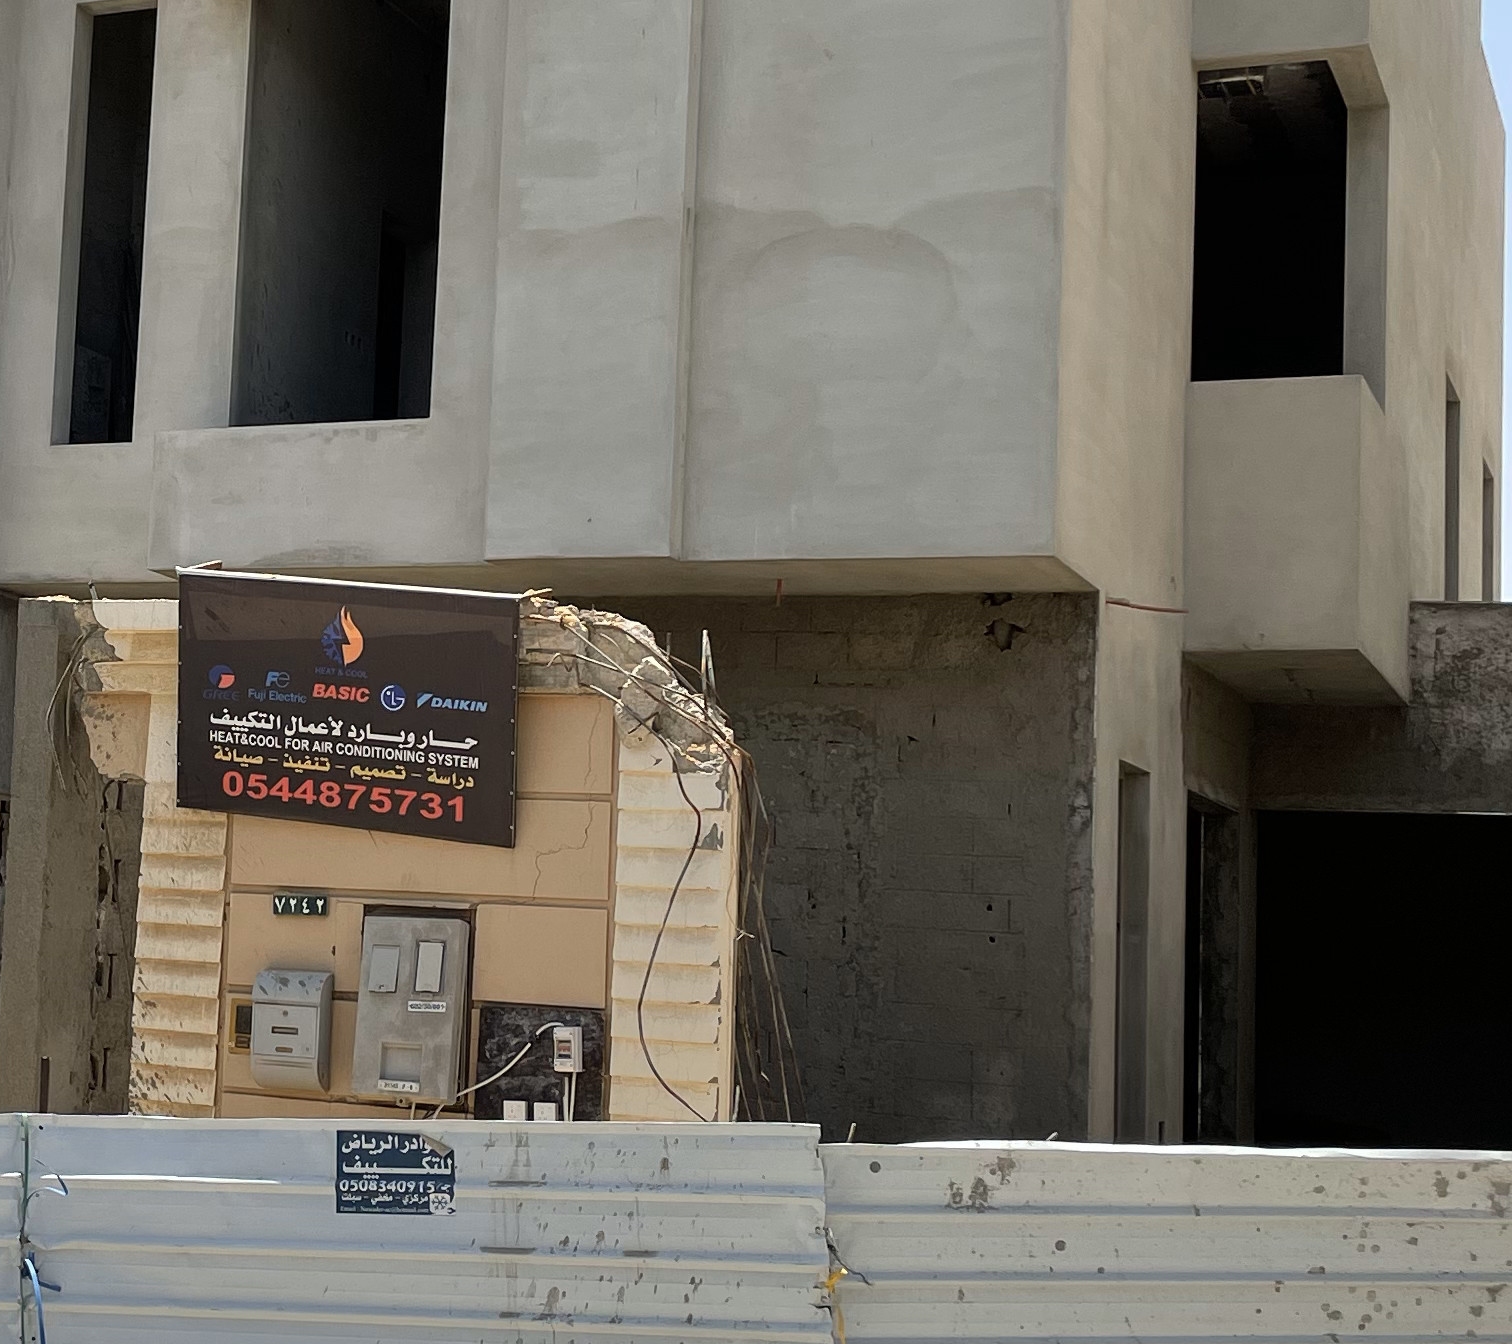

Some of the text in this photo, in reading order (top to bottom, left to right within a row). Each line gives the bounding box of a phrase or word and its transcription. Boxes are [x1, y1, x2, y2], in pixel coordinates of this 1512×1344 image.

[315, 666, 336, 675] HEAT
[345, 669, 369, 679] COOL
[248, 688, 307, 704] Fuji Electric
[312, 683, 370, 703] BASIC
[430, 697, 488, 713] DAIKIN
[210, 708, 478, 750] حار وبارد لأعمال التكييف
[209, 730, 480, 770] HEAT&COOL FOR AIR CONDITIONING SYSTEM
[212, 744, 264, 768] صيانة
[283, 752, 331, 774] تنفيذ
[350, 764, 407, 781] تصميم
[426, 767, 475, 790] دراسة
[222, 770, 465, 823] 0544875731
[274, 897, 325, 914] ٧٢٤٢
[341, 1133, 399, 1154] الرياض
[342, 1155, 453, 1179] للتكييف
[339, 1179, 436, 1193] 0508340915
[370, 1193, 393, 1205] مخفي
[402, 1193, 429, 1205] مركزي
